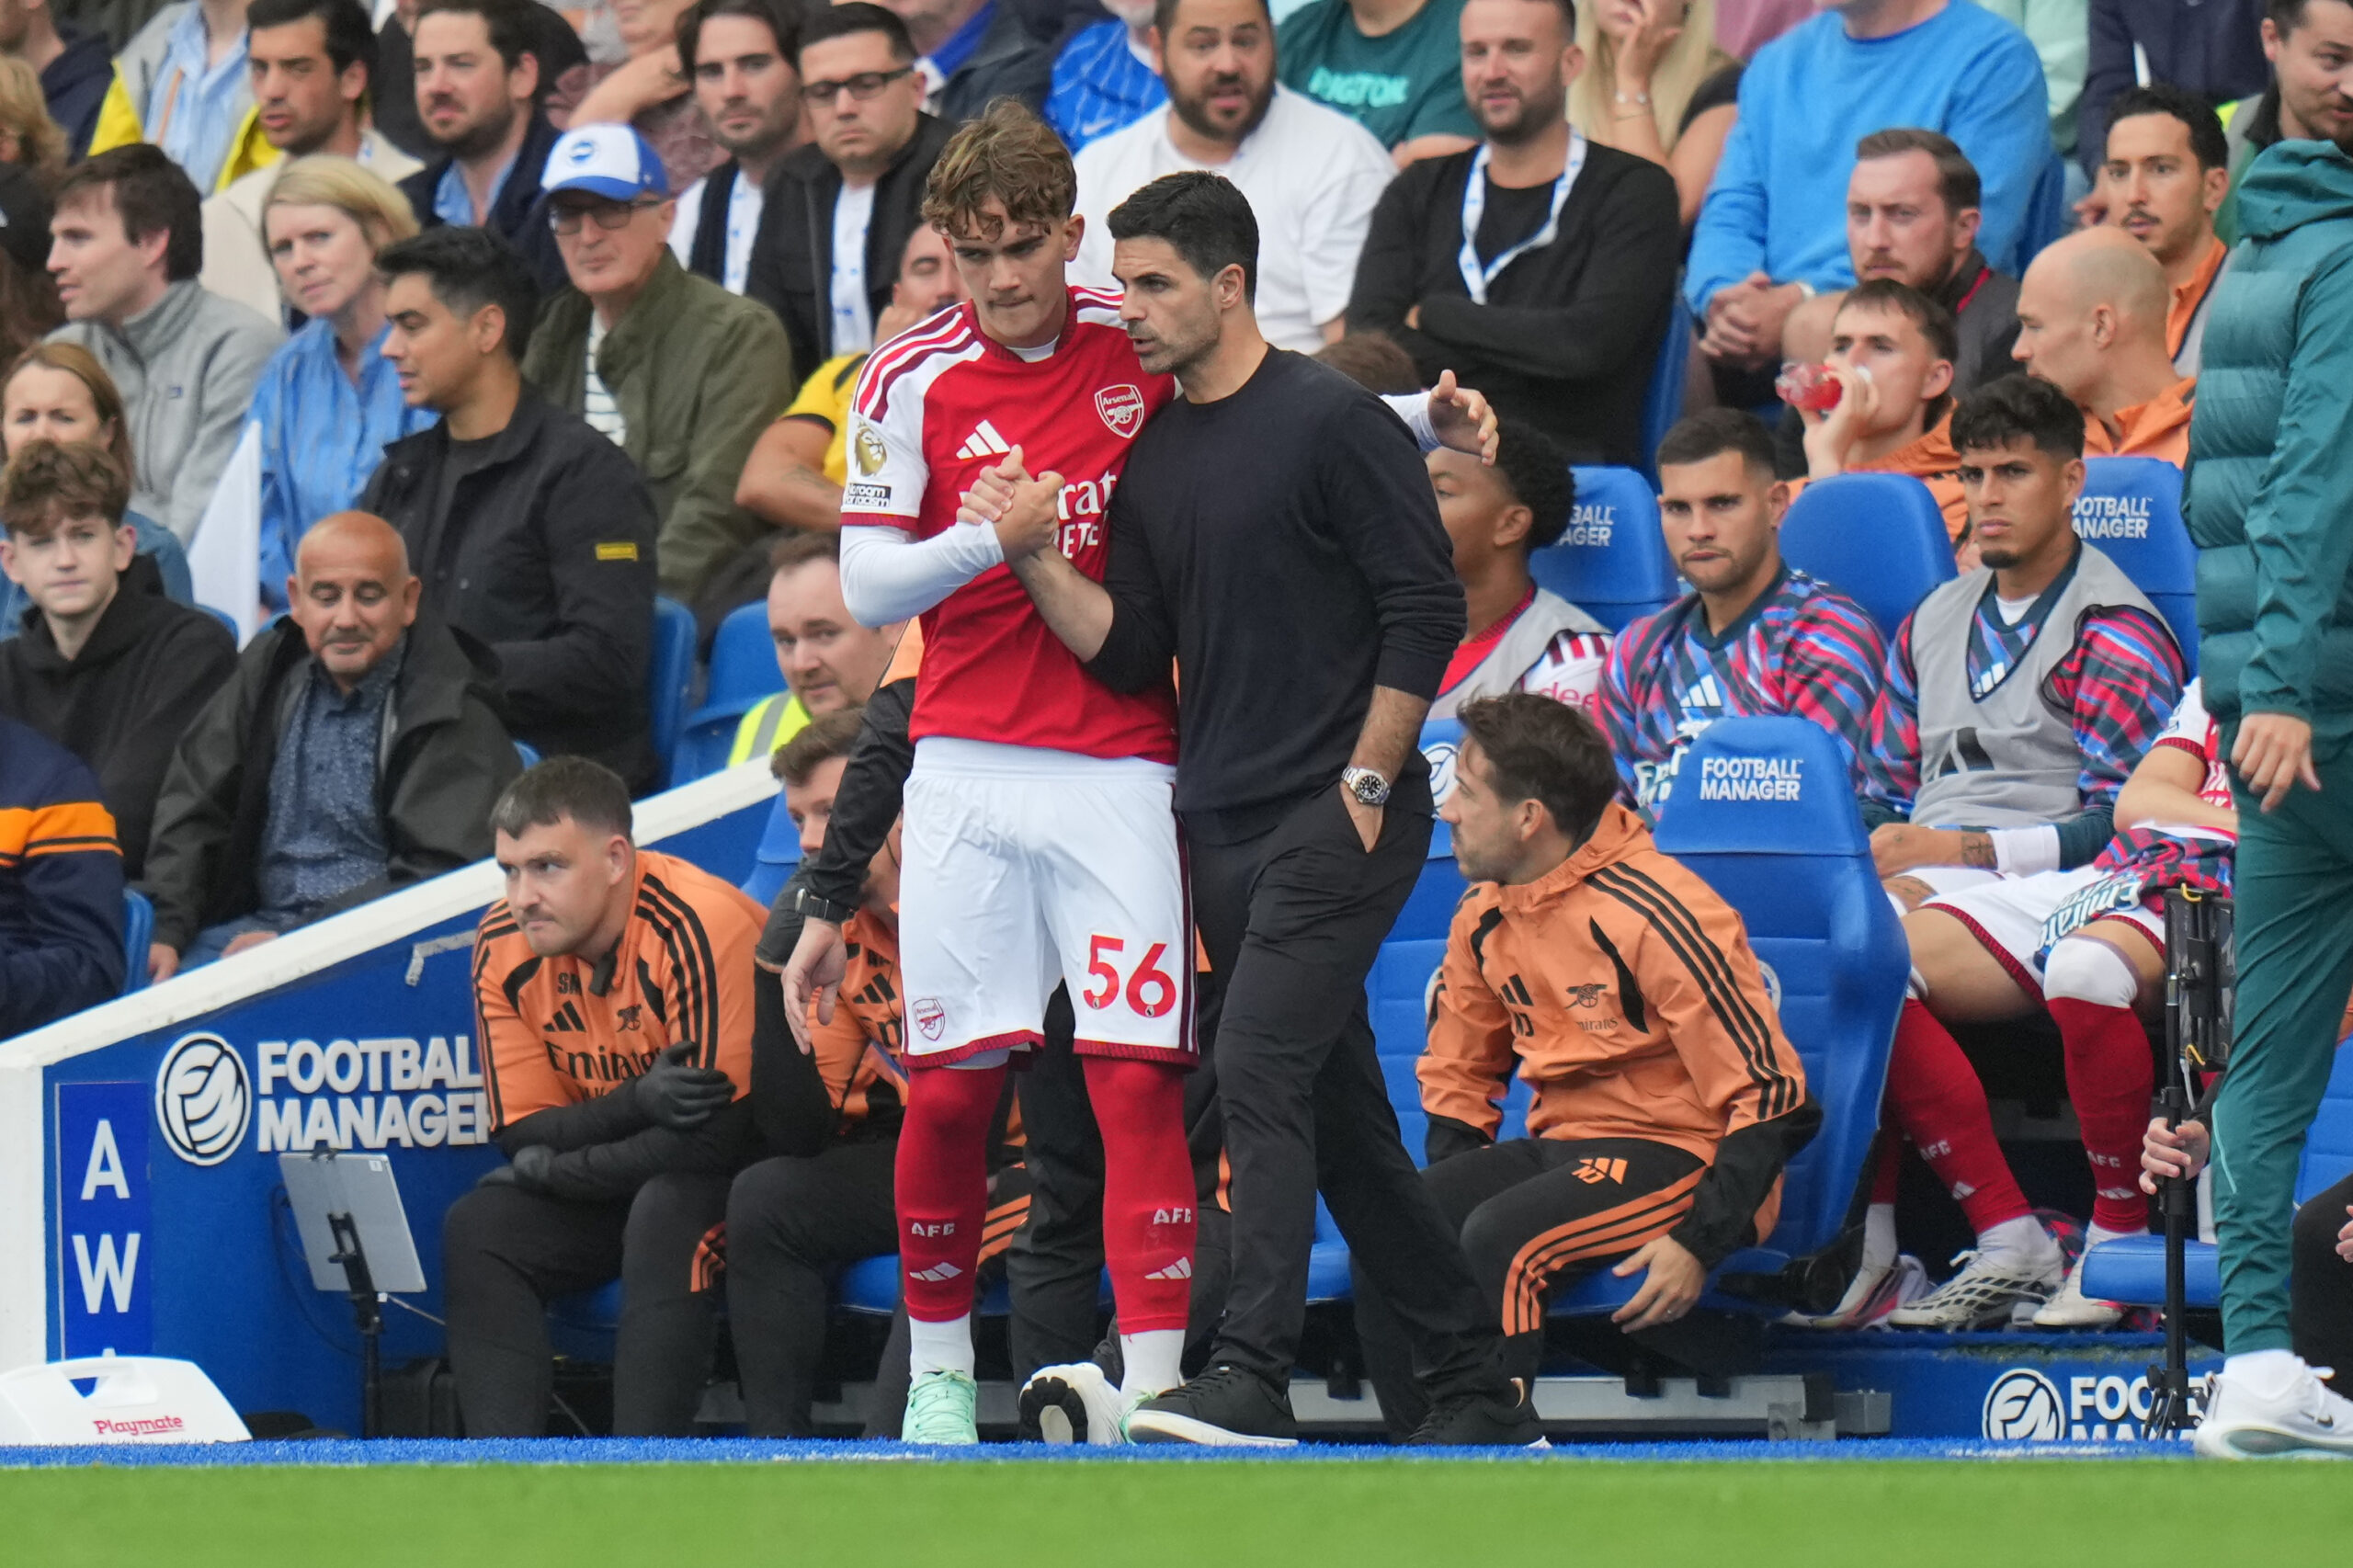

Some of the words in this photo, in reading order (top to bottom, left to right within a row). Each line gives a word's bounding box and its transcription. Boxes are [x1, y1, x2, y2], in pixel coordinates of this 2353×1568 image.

[1103, 392, 1137, 405] Arsenal
[1570, 505, 1615, 527] BALL
[1559, 526, 1612, 547] AGER
[2072, 517, 2149, 540] ANAGER
[1701, 757, 1802, 780] FOOTBALL
[1700, 778, 1802, 801] MANAGER
[1083, 934, 1177, 1018] 56
[257, 1035, 485, 1095] FOOTBAL
[911, 1222, 955, 1238] AFC
[94, 1415, 183, 1436] Playmate
